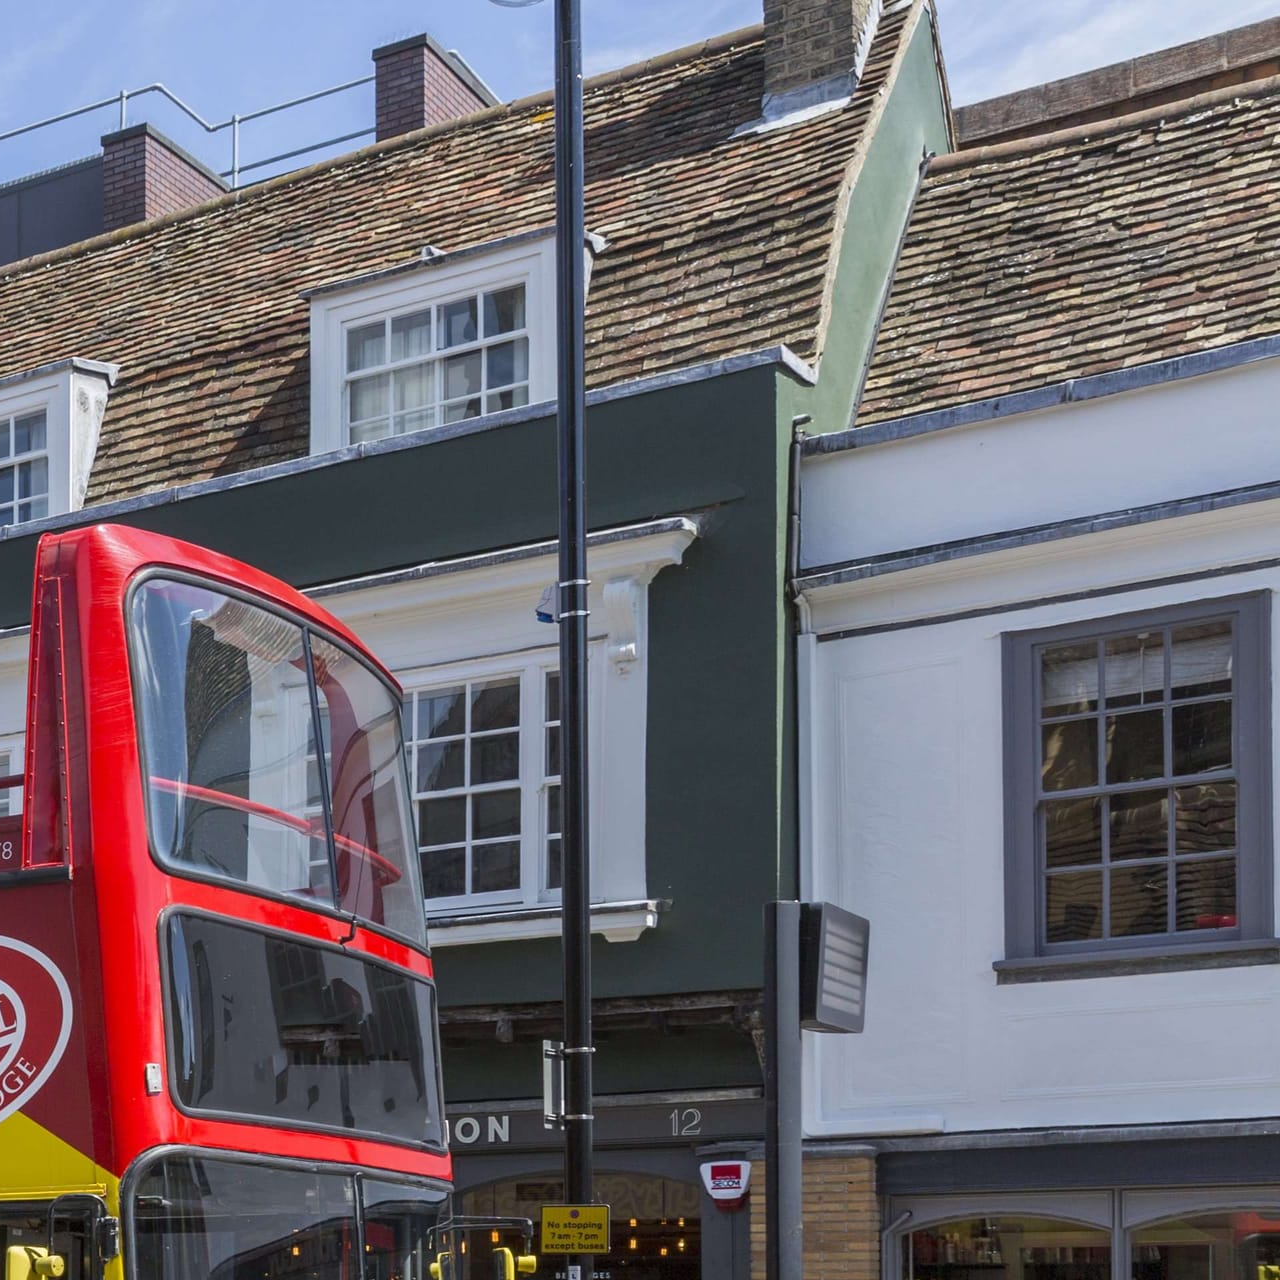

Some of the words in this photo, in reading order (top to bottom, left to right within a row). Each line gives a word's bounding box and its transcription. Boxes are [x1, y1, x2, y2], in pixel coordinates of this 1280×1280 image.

[669, 1108, 702, 1136] 12
[547, 1221, 560, 1229] No
[564, 1221, 603, 1230] stopping
[578, 1242, 605, 1250] buses
